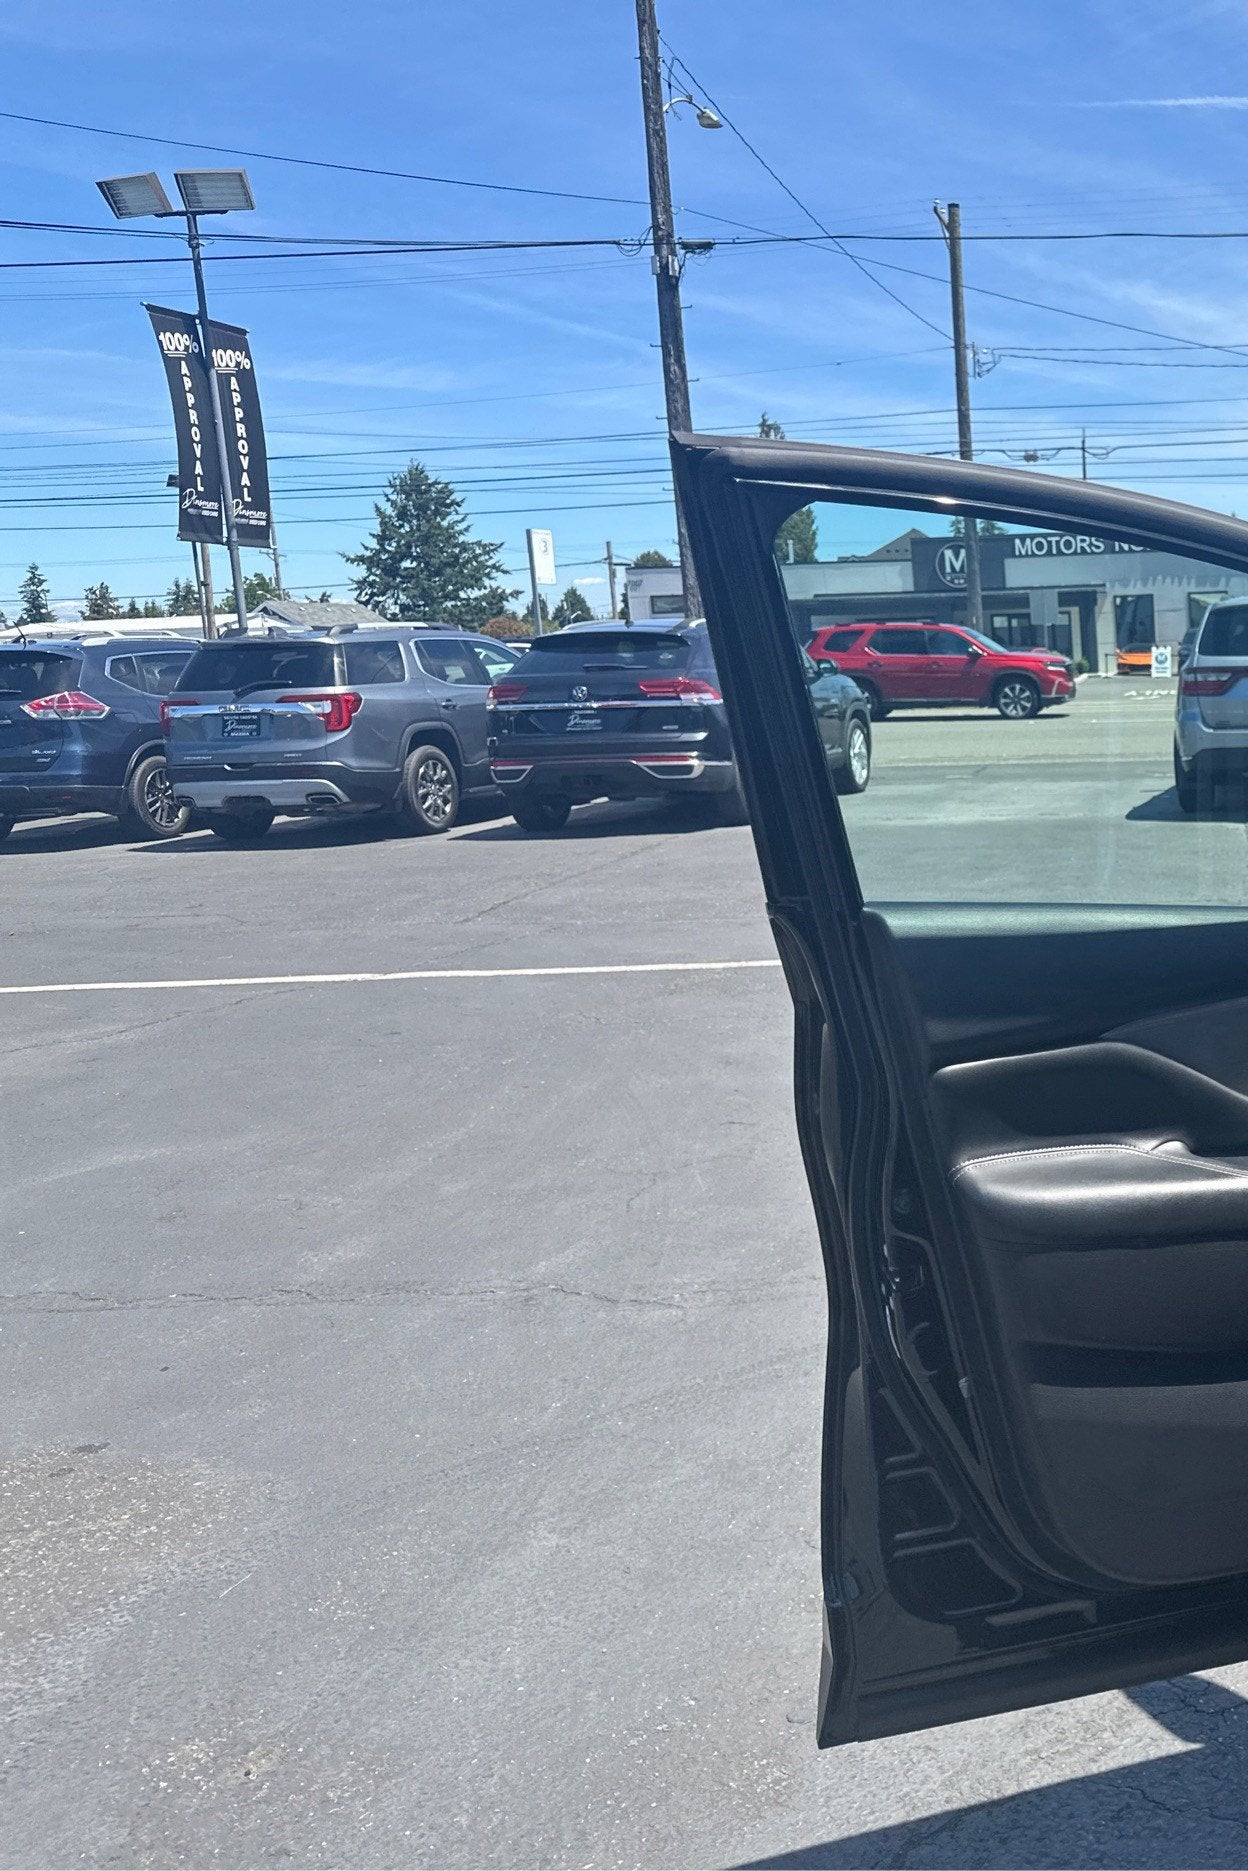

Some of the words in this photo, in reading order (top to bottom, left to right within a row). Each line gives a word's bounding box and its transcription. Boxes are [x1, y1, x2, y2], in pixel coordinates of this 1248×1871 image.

[158, 331, 199, 353] 100%
[211, 349, 251, 370] 100%
[180, 360, 204, 492] APPROVAL
[230, 376, 252, 502] APPROVAL
[1014, 535, 1105, 556] MOTORS
